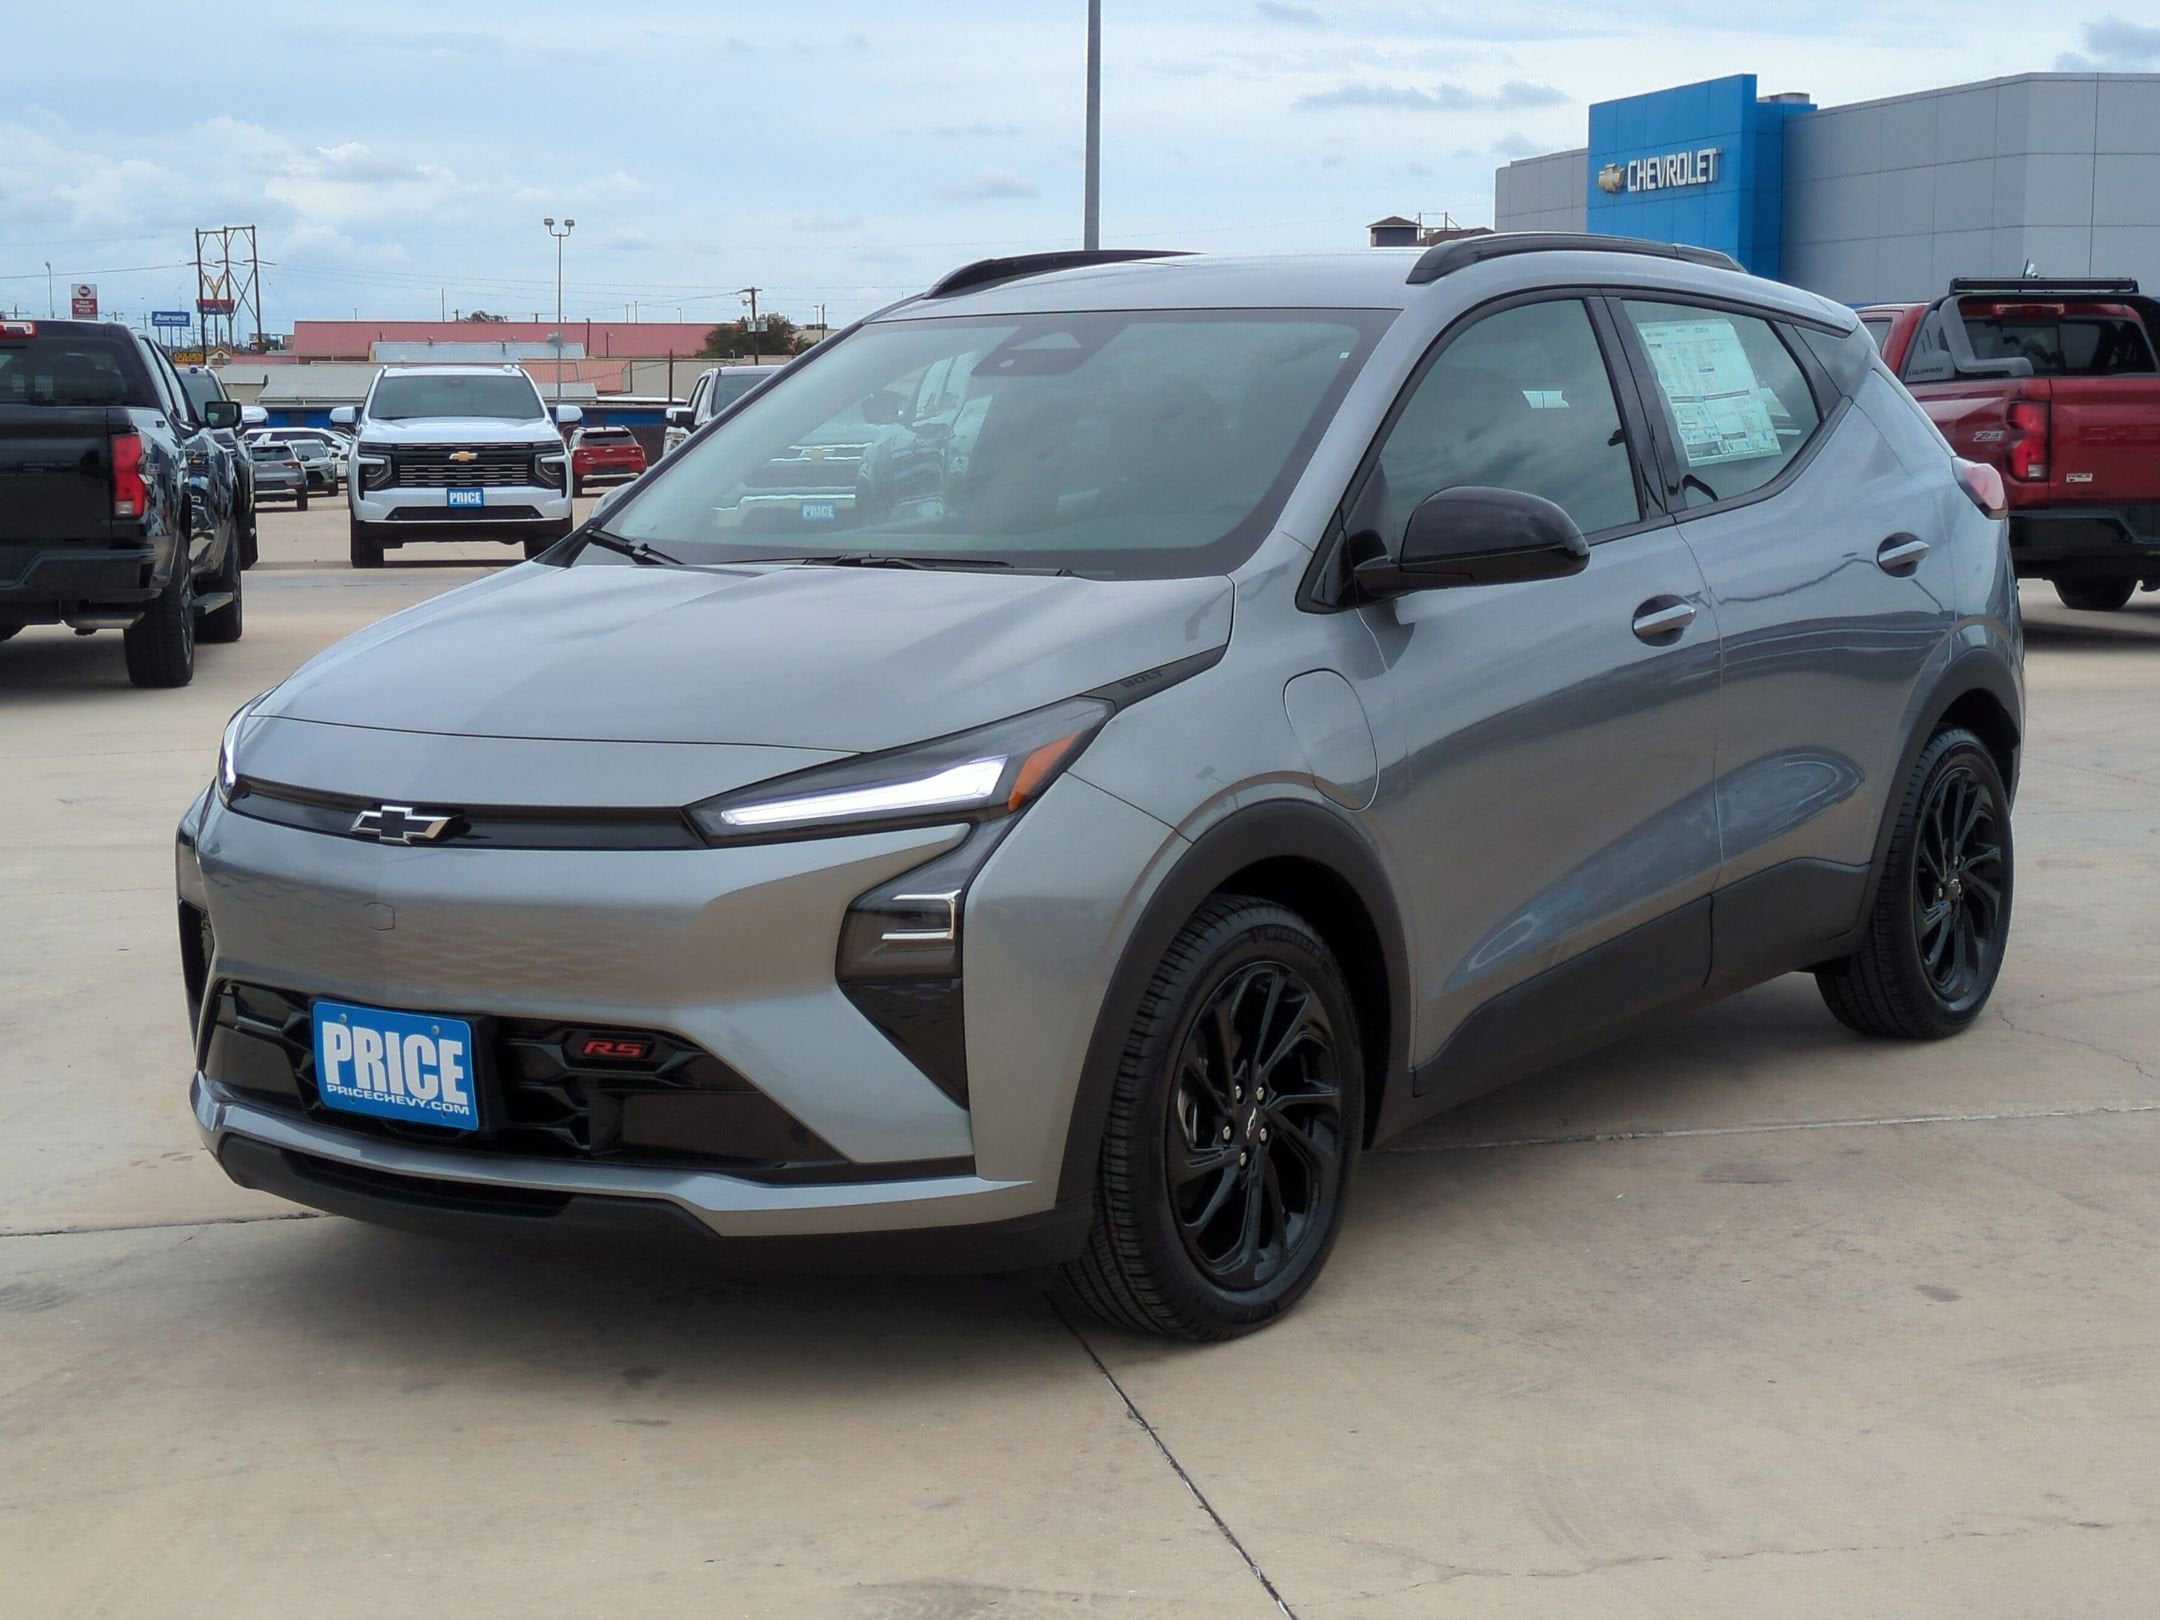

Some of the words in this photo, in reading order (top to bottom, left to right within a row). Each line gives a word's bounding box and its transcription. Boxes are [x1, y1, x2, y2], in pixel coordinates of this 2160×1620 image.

[1627, 148, 1718, 192] CHEVROLET
[449, 491, 482, 504] PRICE
[1121, 670, 1163, 688] BOLT
[583, 1040, 644, 1056] RS
[322, 1021, 468, 1104] PRICE
[327, 1084, 470, 1115] PRICECHEVY.COM
